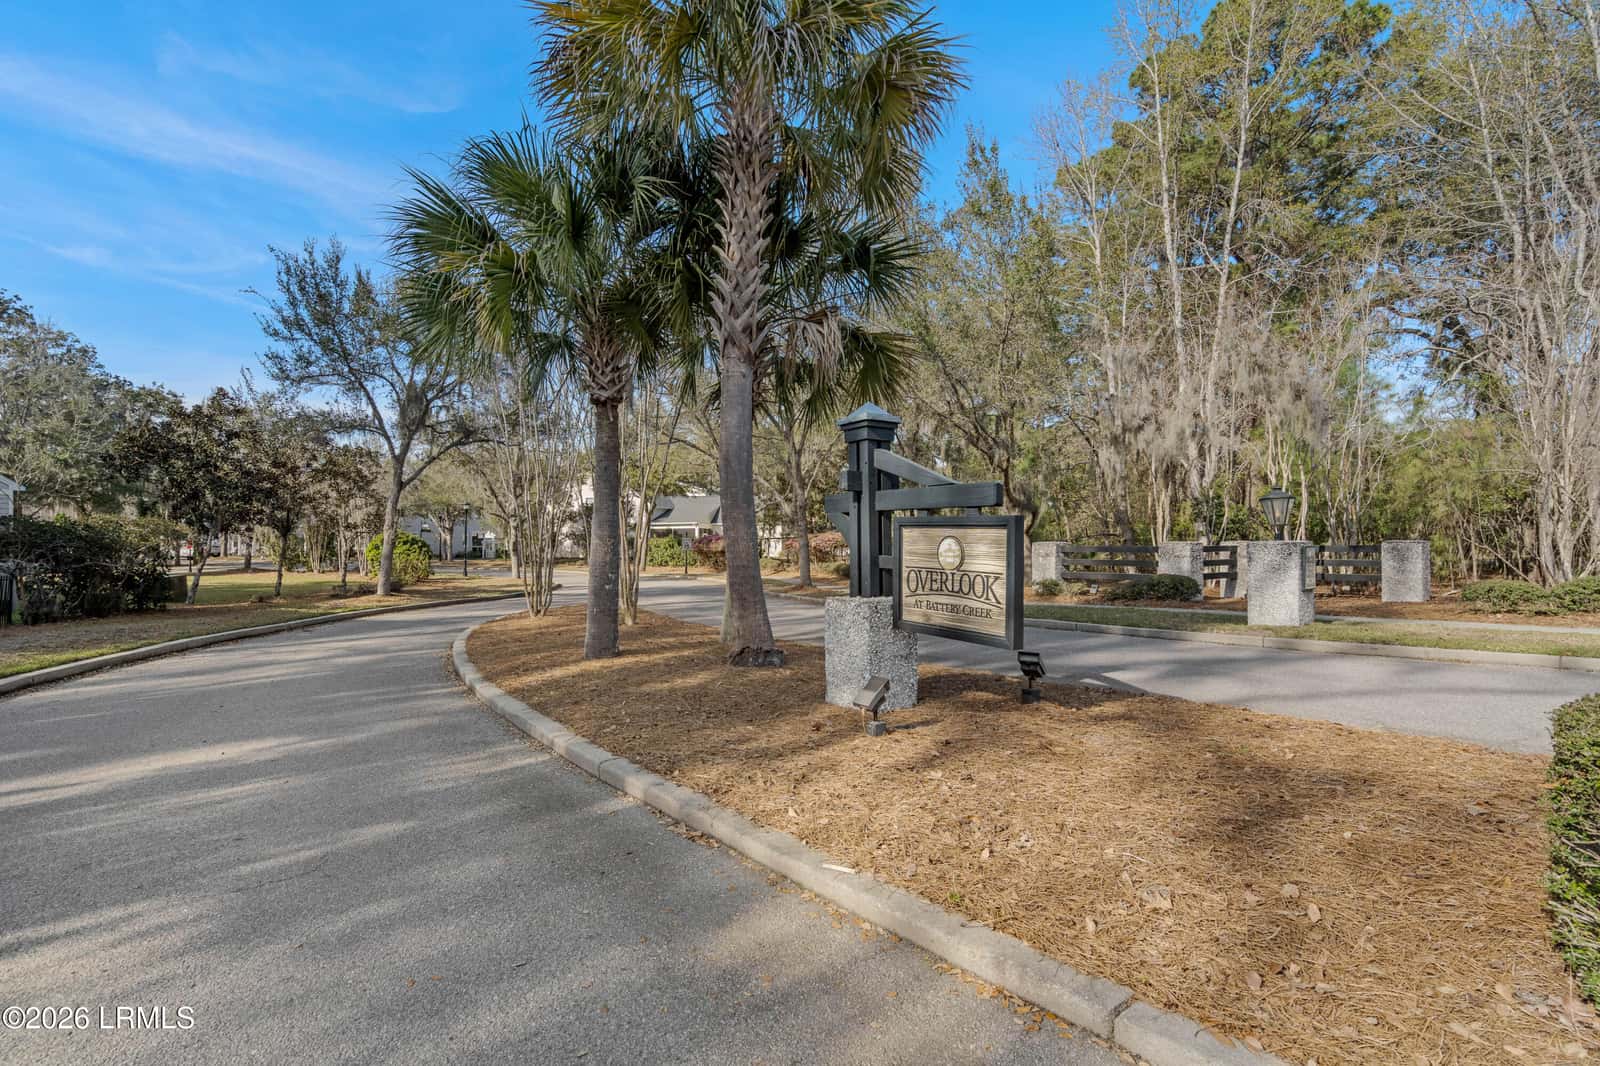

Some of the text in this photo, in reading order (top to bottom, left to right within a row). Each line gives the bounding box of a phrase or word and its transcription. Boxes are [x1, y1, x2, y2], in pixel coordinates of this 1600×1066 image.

[906, 569, 1001, 605] OVERLOOK
[913, 600, 993, 619] AT BATTERY CREEK
